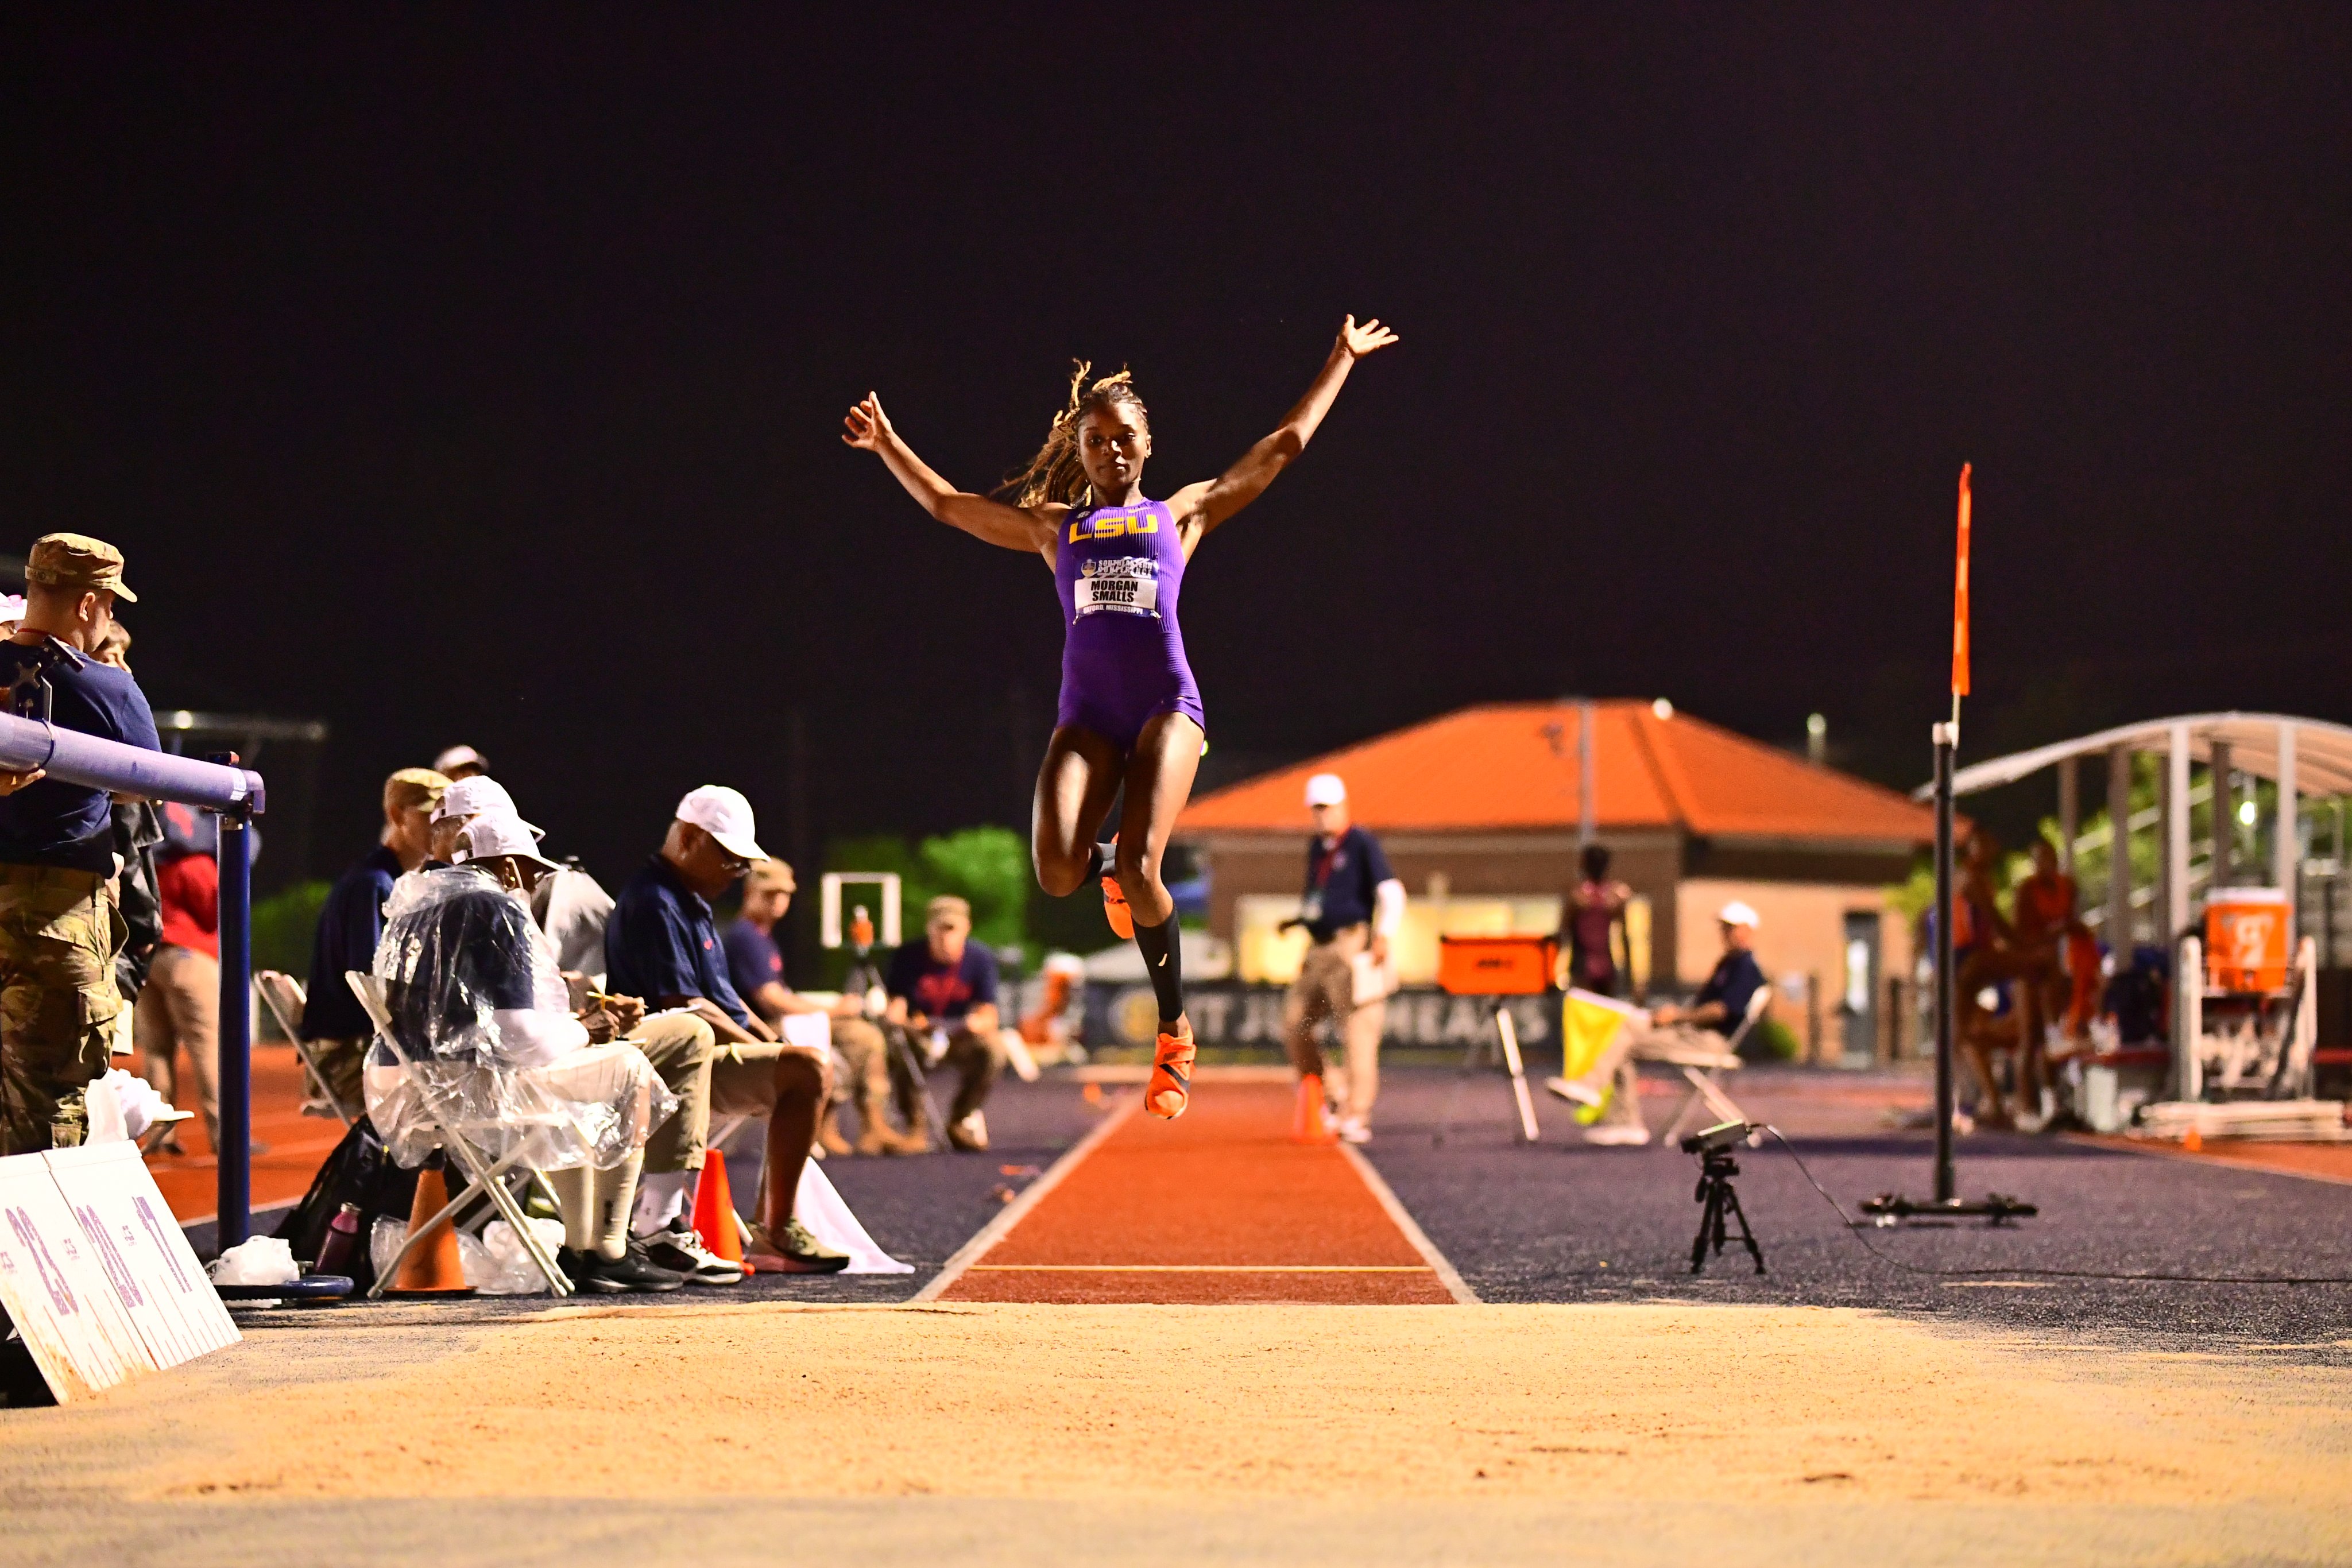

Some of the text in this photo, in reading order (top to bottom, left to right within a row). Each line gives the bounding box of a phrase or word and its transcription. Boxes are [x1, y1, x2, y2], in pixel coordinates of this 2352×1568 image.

[1069, 514, 1159, 544] LSU
[1090, 580, 1138, 592] MORGAN
[1092, 591, 1135, 603] SMALLS
[1106, 605, 1143, 615] MISSISSIPPI
[76, 1205, 143, 1308] 20
[131, 1197, 192, 1293] 17
[5, 1206, 79, 1316] 23
